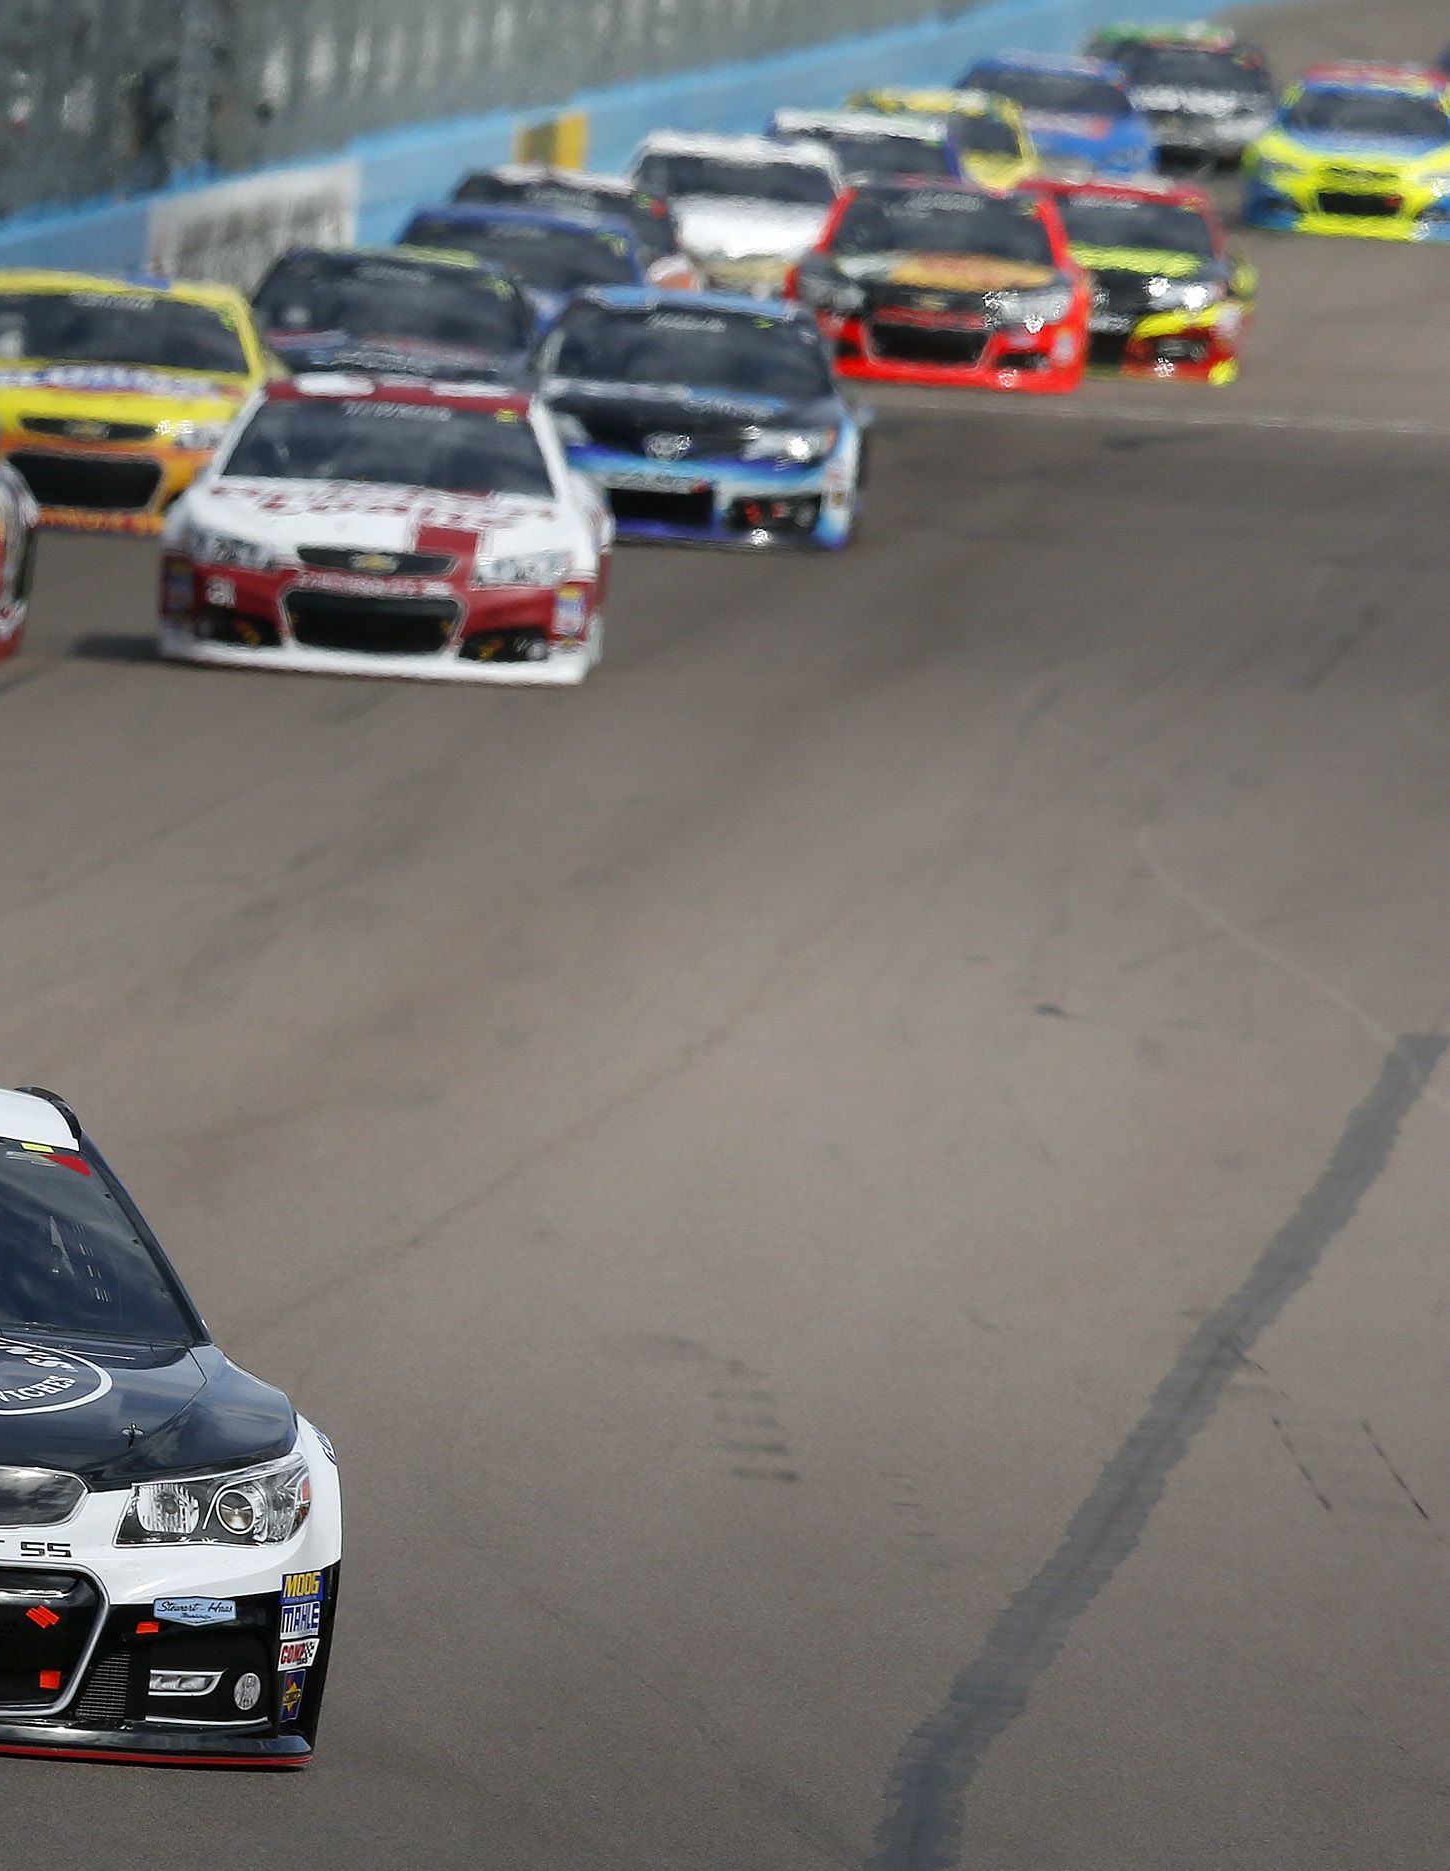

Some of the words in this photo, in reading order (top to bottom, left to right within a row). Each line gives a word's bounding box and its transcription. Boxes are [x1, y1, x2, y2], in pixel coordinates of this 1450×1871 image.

[20, 1541, 73, 1558] SS
[282, 1571, 322, 1598] MOOG
[281, 1603, 320, 1633] MAHLE
